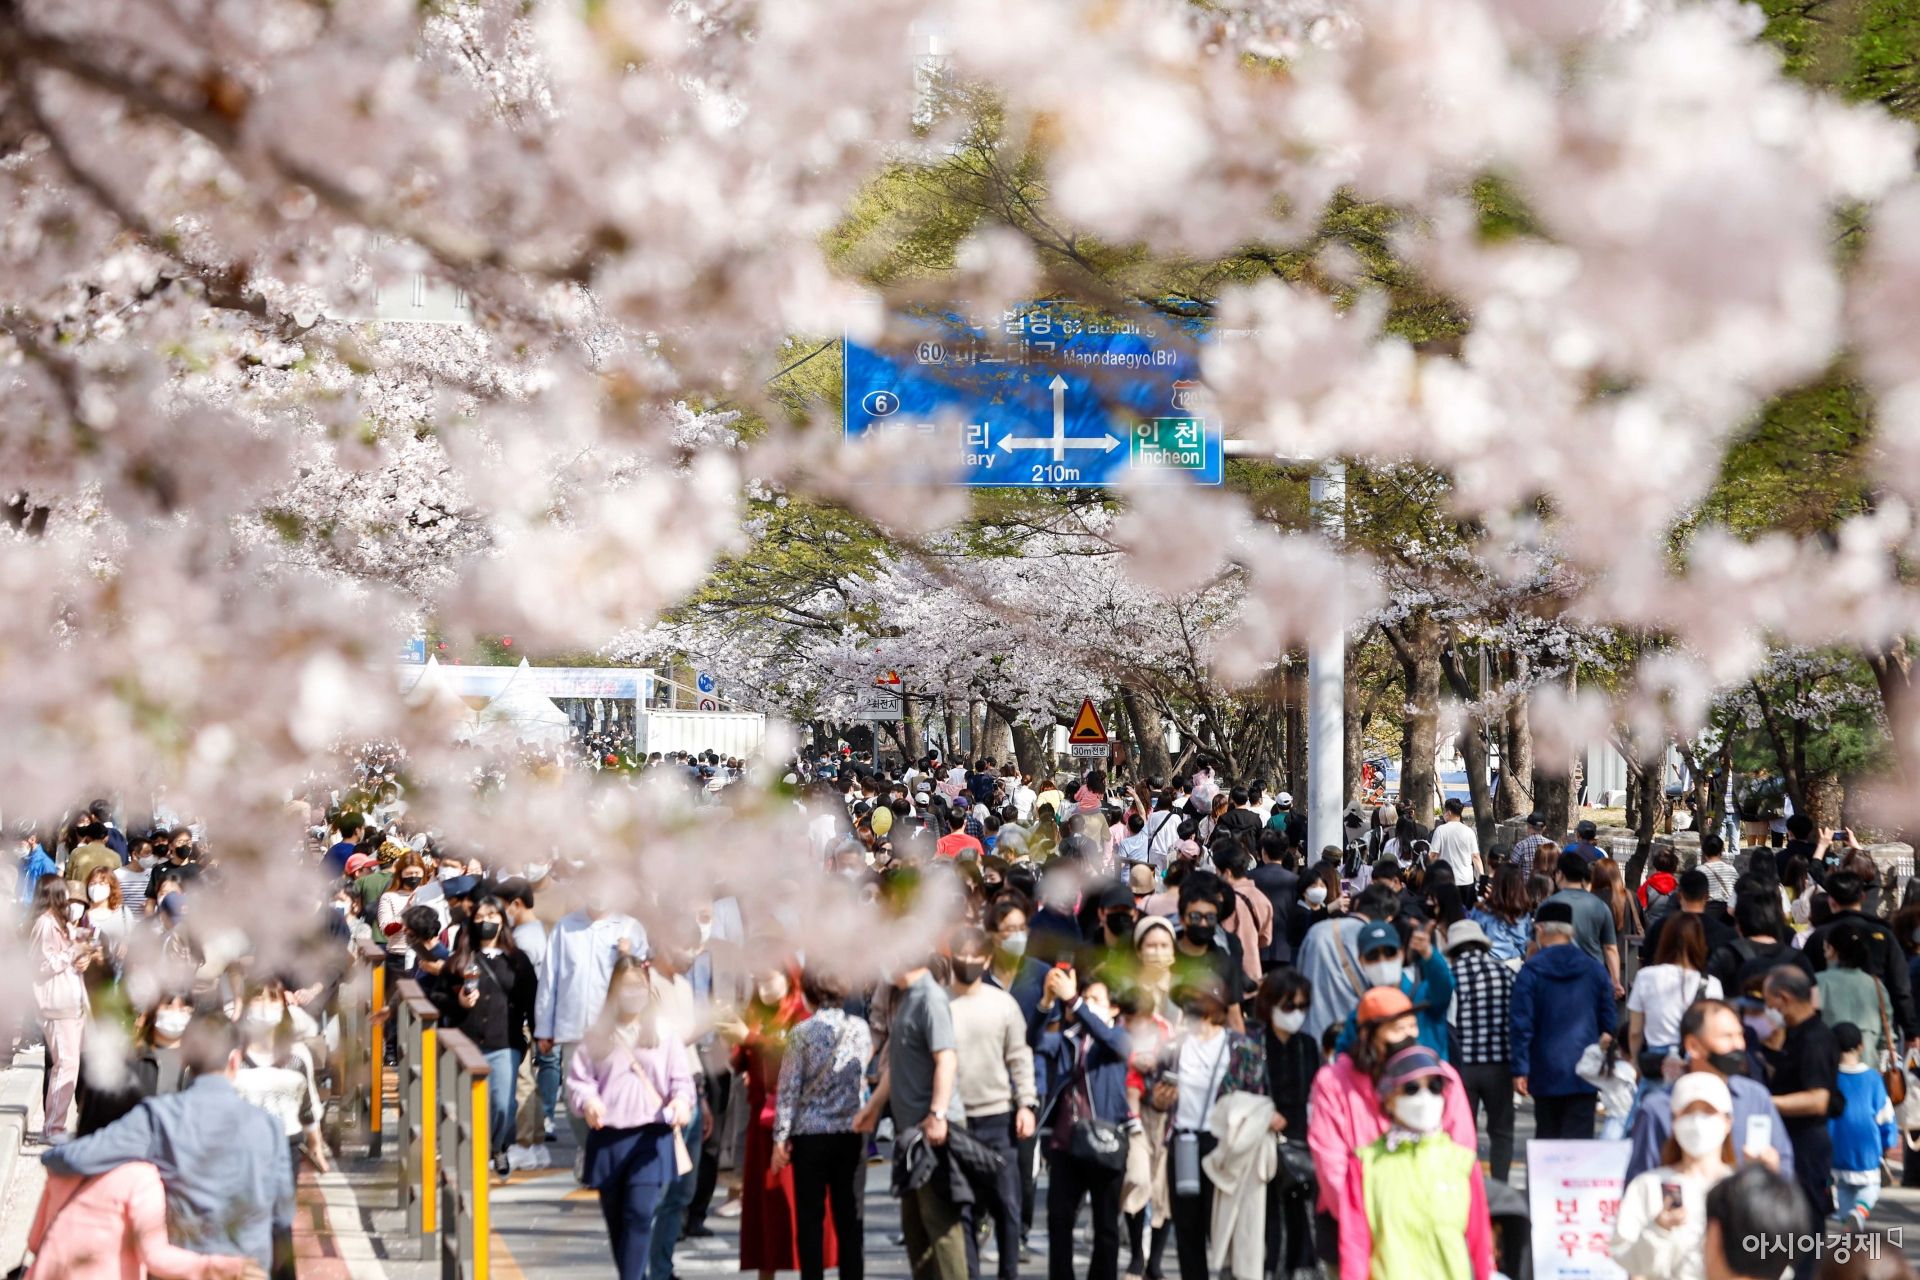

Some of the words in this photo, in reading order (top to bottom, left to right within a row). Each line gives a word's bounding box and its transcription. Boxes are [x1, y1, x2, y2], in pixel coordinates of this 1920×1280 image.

[920, 342, 942, 361] 60
[1063, 349, 1177, 369] Mapodaegyo(Br)
[875, 395, 888, 413] 6
[1140, 448, 1200, 464] Incheon
[1031, 465, 1081, 483] 210m
